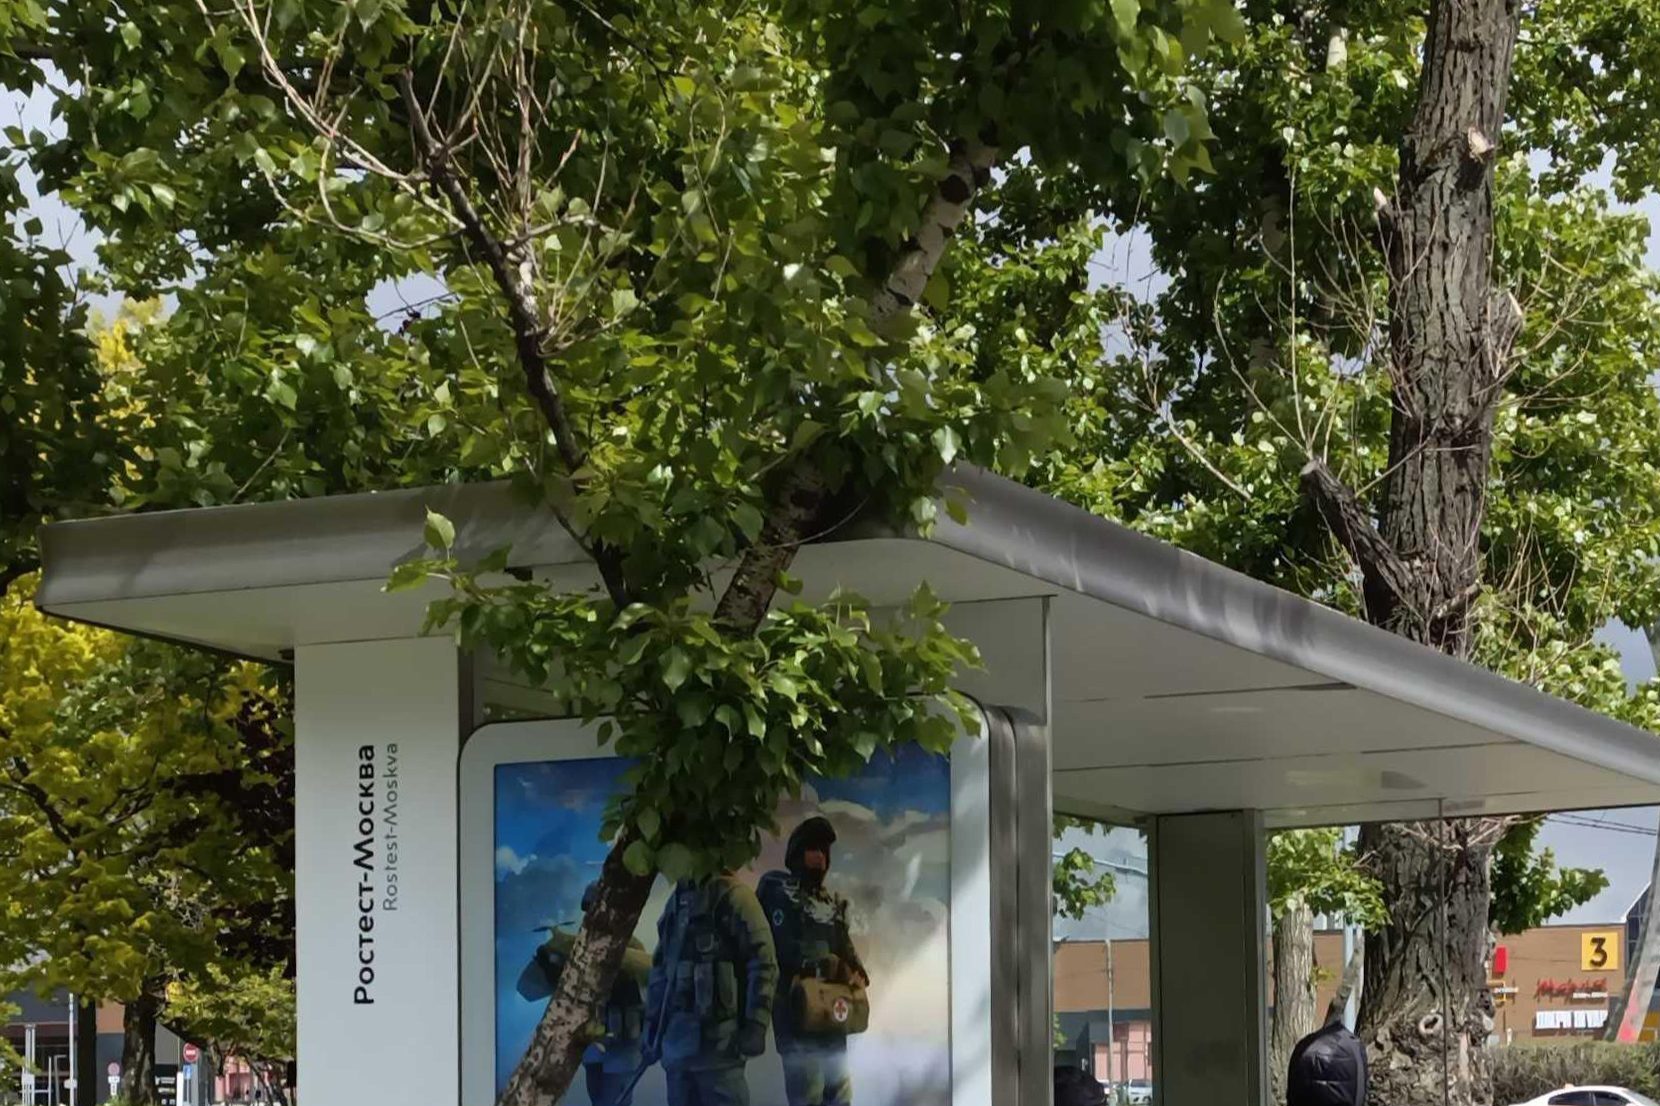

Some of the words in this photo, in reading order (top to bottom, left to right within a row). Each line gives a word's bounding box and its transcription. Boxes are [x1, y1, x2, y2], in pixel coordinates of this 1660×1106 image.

[353, 744, 375, 1005] Ростест-Москва
[382, 743, 398, 911] Rostest-Moskva
[1589, 937, 1608, 967] 3
